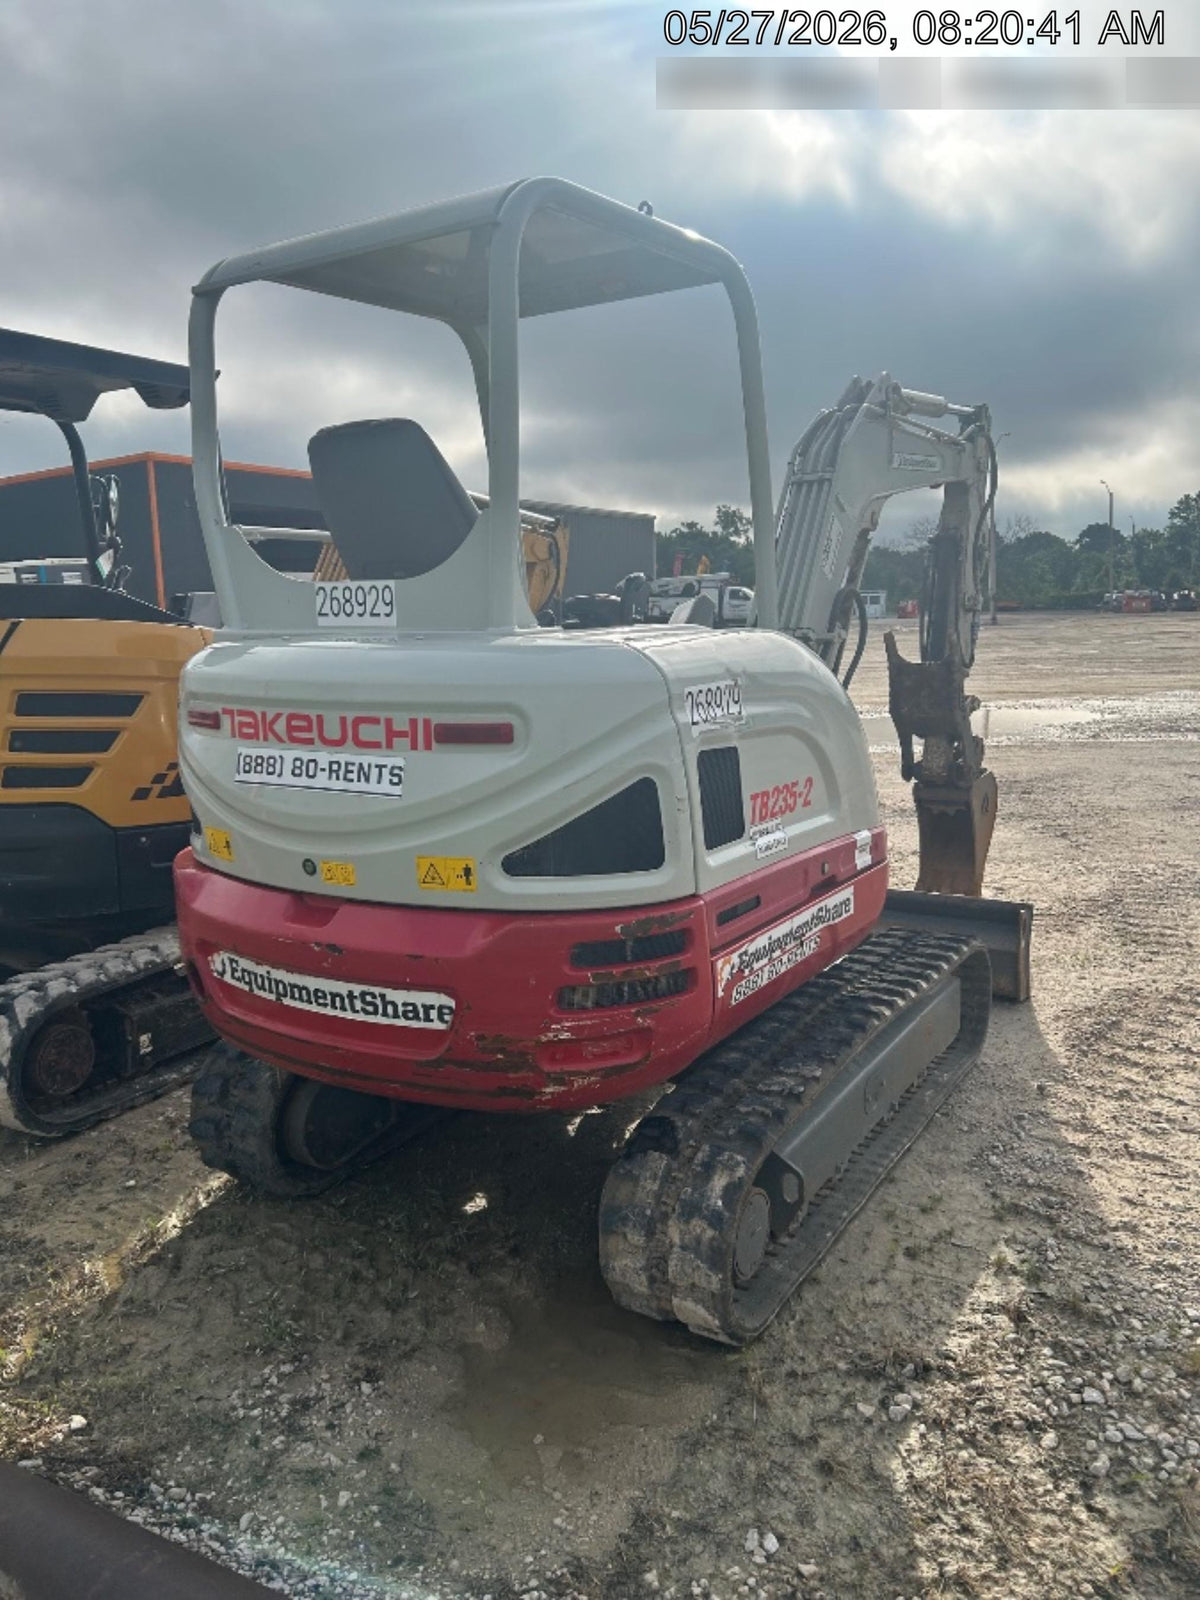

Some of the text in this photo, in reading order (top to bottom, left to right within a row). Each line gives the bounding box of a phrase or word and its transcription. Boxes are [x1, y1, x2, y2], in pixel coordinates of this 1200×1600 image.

[316, 585, 394, 617] 268929
[236, 752, 403, 786] (888) 80-RENTS
[750, 776, 814, 825] TB235-2
[230, 957, 454, 1025] EquipmentShare
